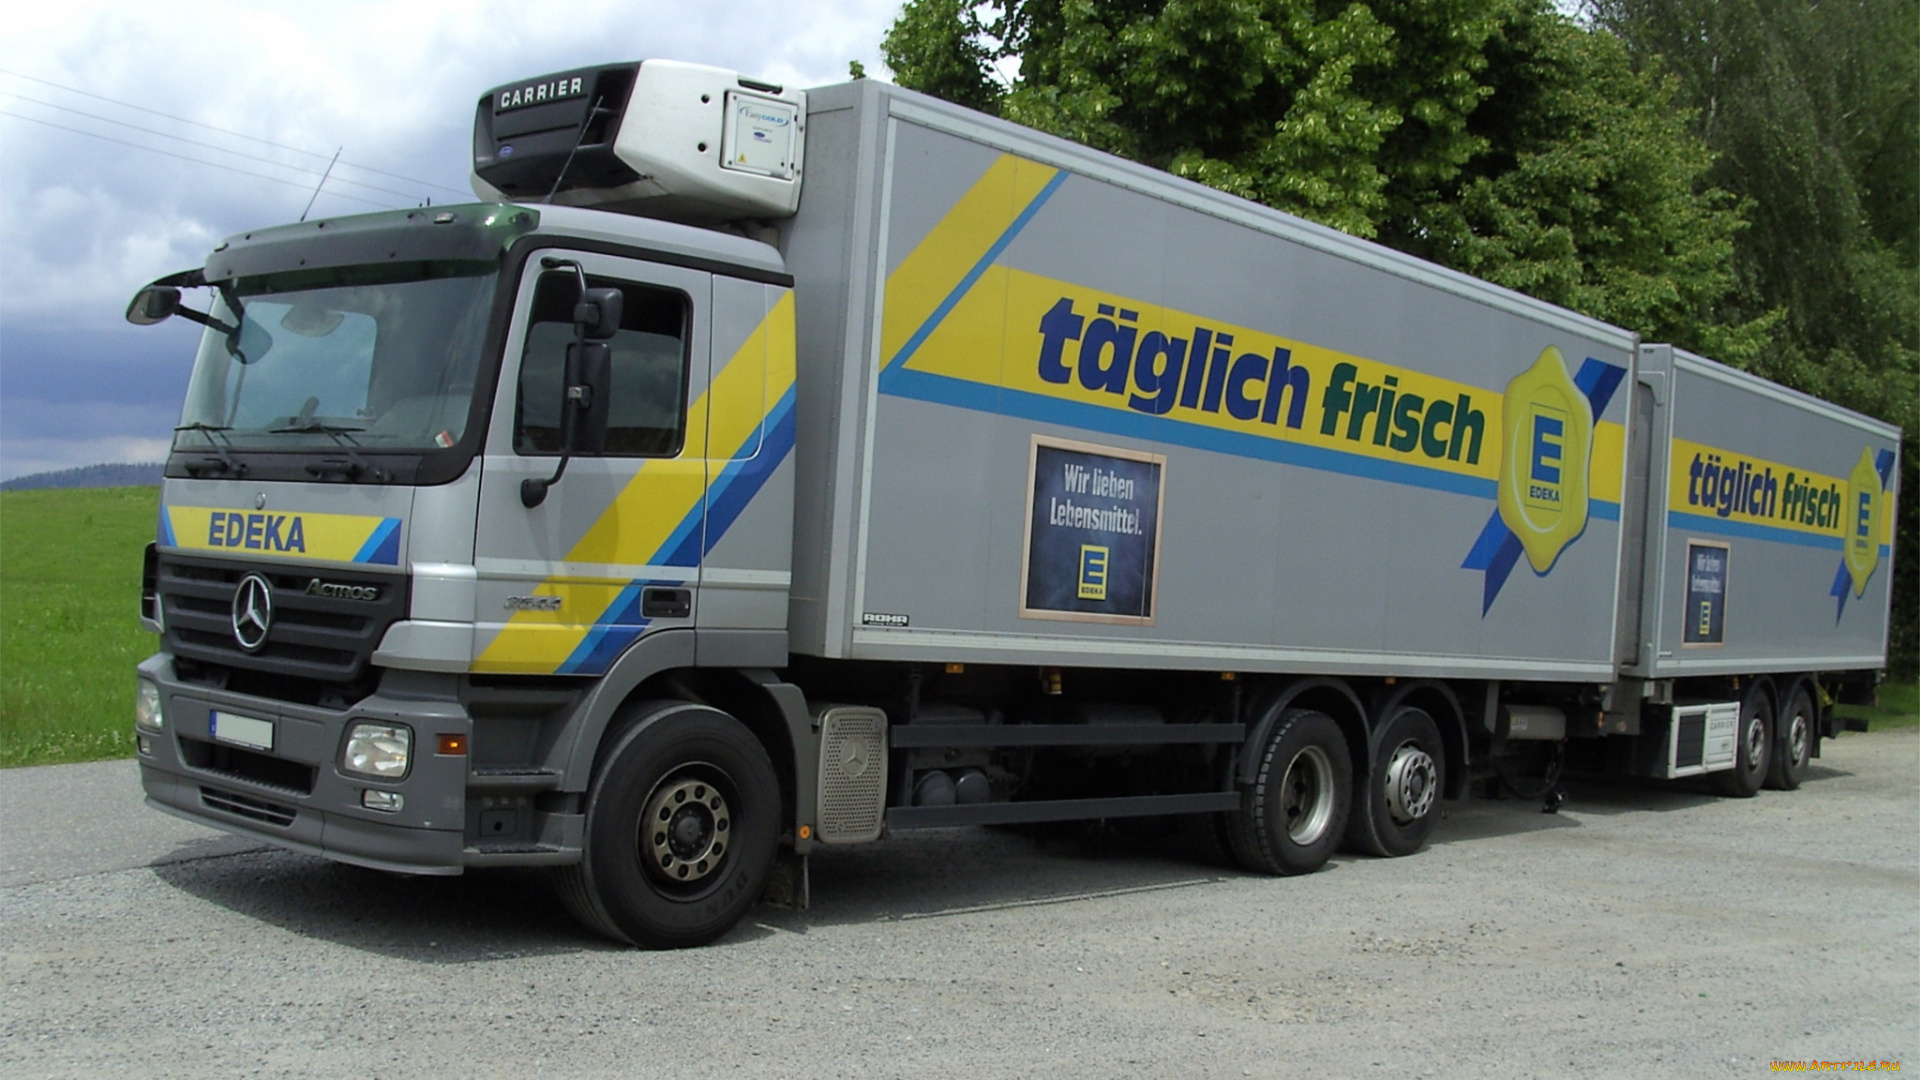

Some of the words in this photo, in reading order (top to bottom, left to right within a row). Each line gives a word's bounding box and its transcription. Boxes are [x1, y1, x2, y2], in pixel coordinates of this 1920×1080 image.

[501, 77, 582, 108] CARRIER
[1038, 297, 1310, 430] täglich
[1320, 362, 1486, 466] frisch
[1531, 415, 1563, 484] E
[1065, 463, 1091, 494] Wir
[1092, 468, 1134, 500] lieben
[1529, 485, 1560, 502] EDEKA
[1688, 453, 1778, 518] täglich
[1781, 472, 1841, 529] frisch
[208, 512, 305, 553] EDEKA
[1050, 497, 1142, 535] Lebensmittel.
[1081, 586, 1103, 595] EDEKA
[864, 613, 908, 623] ROHR
